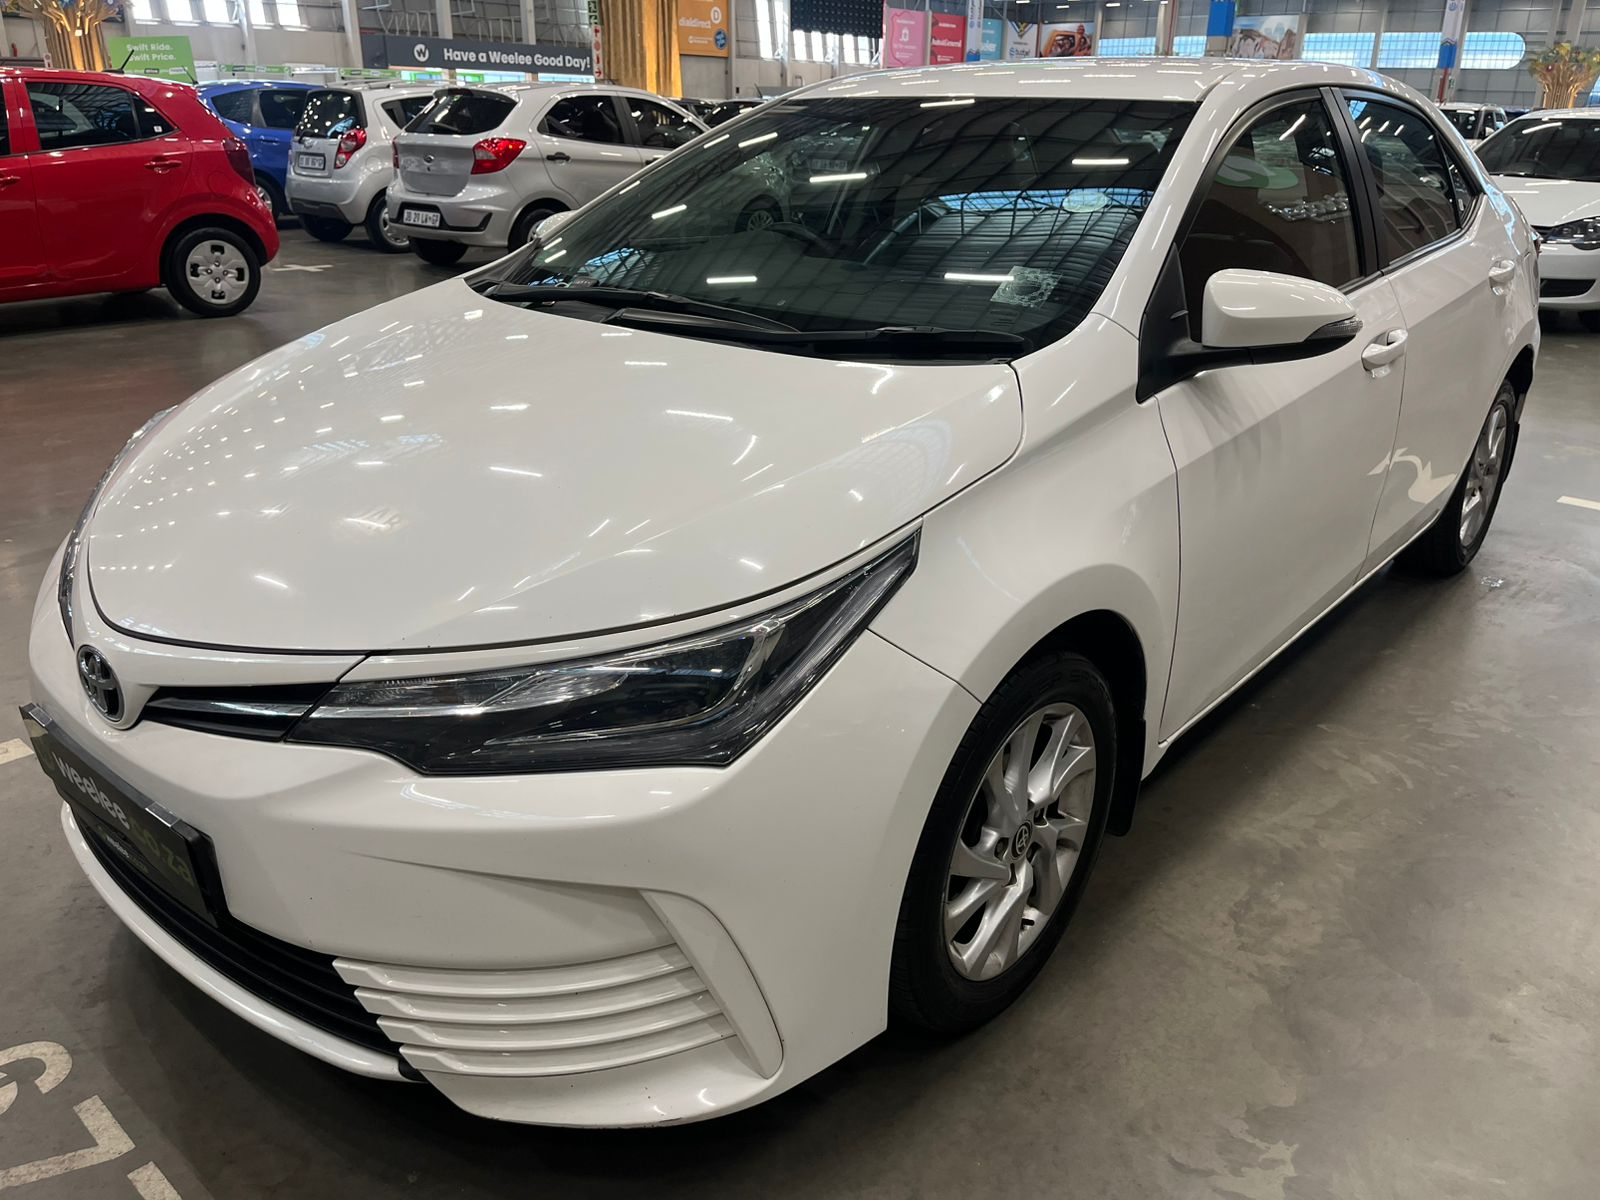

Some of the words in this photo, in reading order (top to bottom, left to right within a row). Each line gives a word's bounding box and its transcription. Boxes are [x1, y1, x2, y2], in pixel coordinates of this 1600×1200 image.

[150, 43, 173, 51] Ride.
[152, 53, 176, 61] Price.
[443, 48, 476, 62] Have
[478, 53, 487, 63] a
[489, 51, 532, 65] Weelee
[534, 54, 563, 67] Good
[565, 56, 590, 71] Day!
